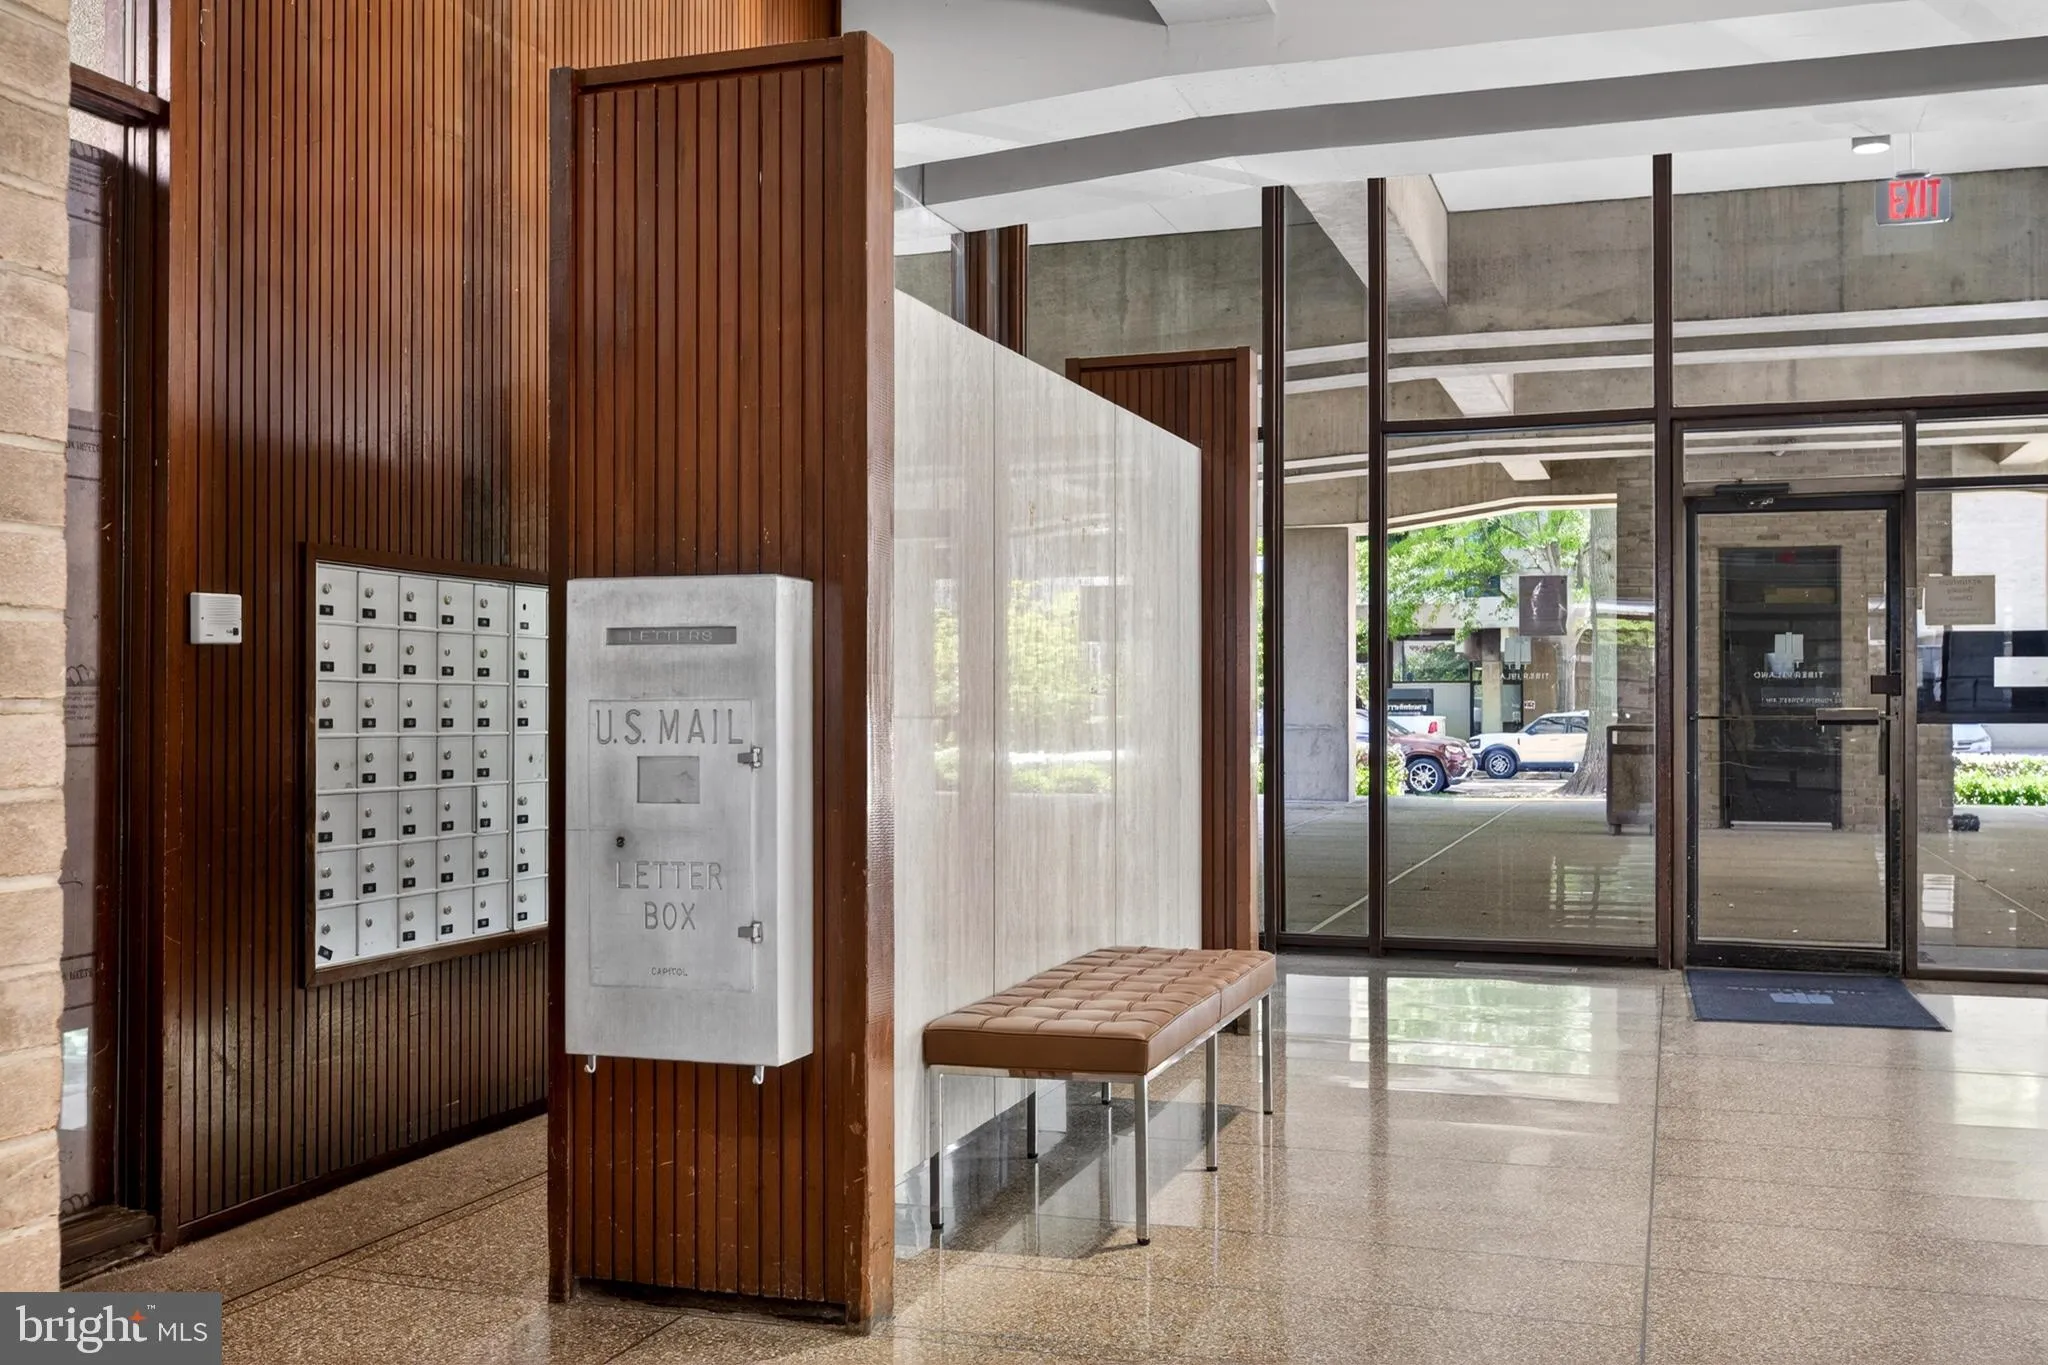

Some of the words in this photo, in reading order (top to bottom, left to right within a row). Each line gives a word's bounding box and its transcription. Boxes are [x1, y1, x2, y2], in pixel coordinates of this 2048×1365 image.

[1888, 178, 1942, 220] EXIT
[628, 630, 713, 642] LETTERS
[596, 708, 646, 745] U.S.
[658, 708, 744, 745] MAIL
[615, 860, 723, 891] LETTER
[644, 900, 696, 931] BOX
[651, 966, 688, 977] CAPITOL
